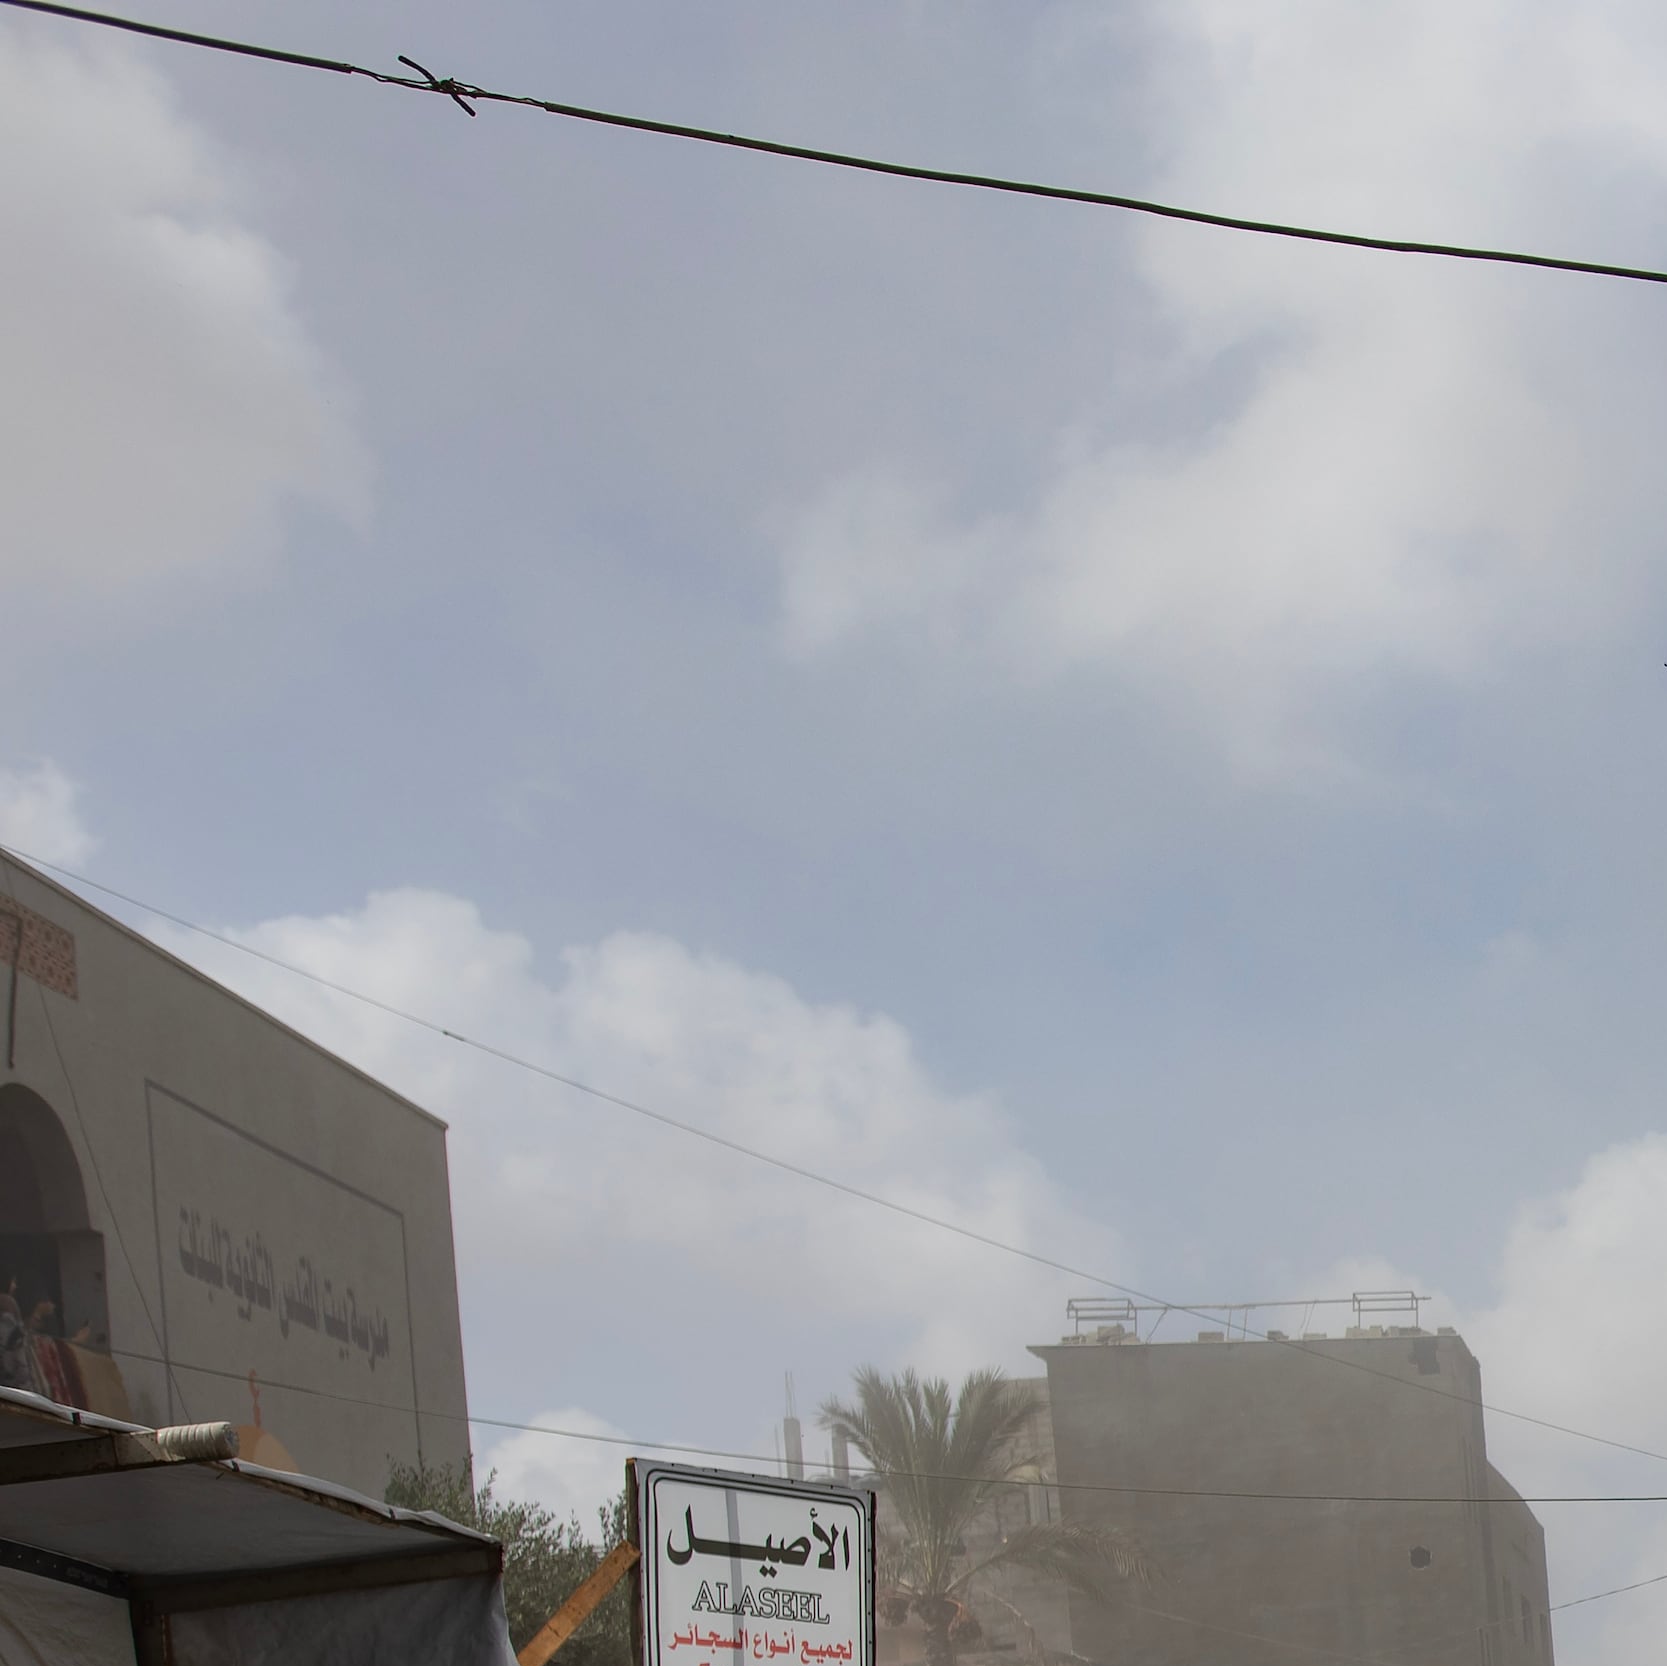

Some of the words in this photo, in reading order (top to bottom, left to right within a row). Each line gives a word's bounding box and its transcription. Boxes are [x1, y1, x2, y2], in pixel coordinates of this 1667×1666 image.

[667, 1504, 850, 1577] الأصيل
[692, 1580, 830, 1624] ALASEEL
[669, 1623, 749, 1654] السجائر
[753, 1627, 796, 1659] أنواع
[801, 1639, 853, 1666] لجميع
